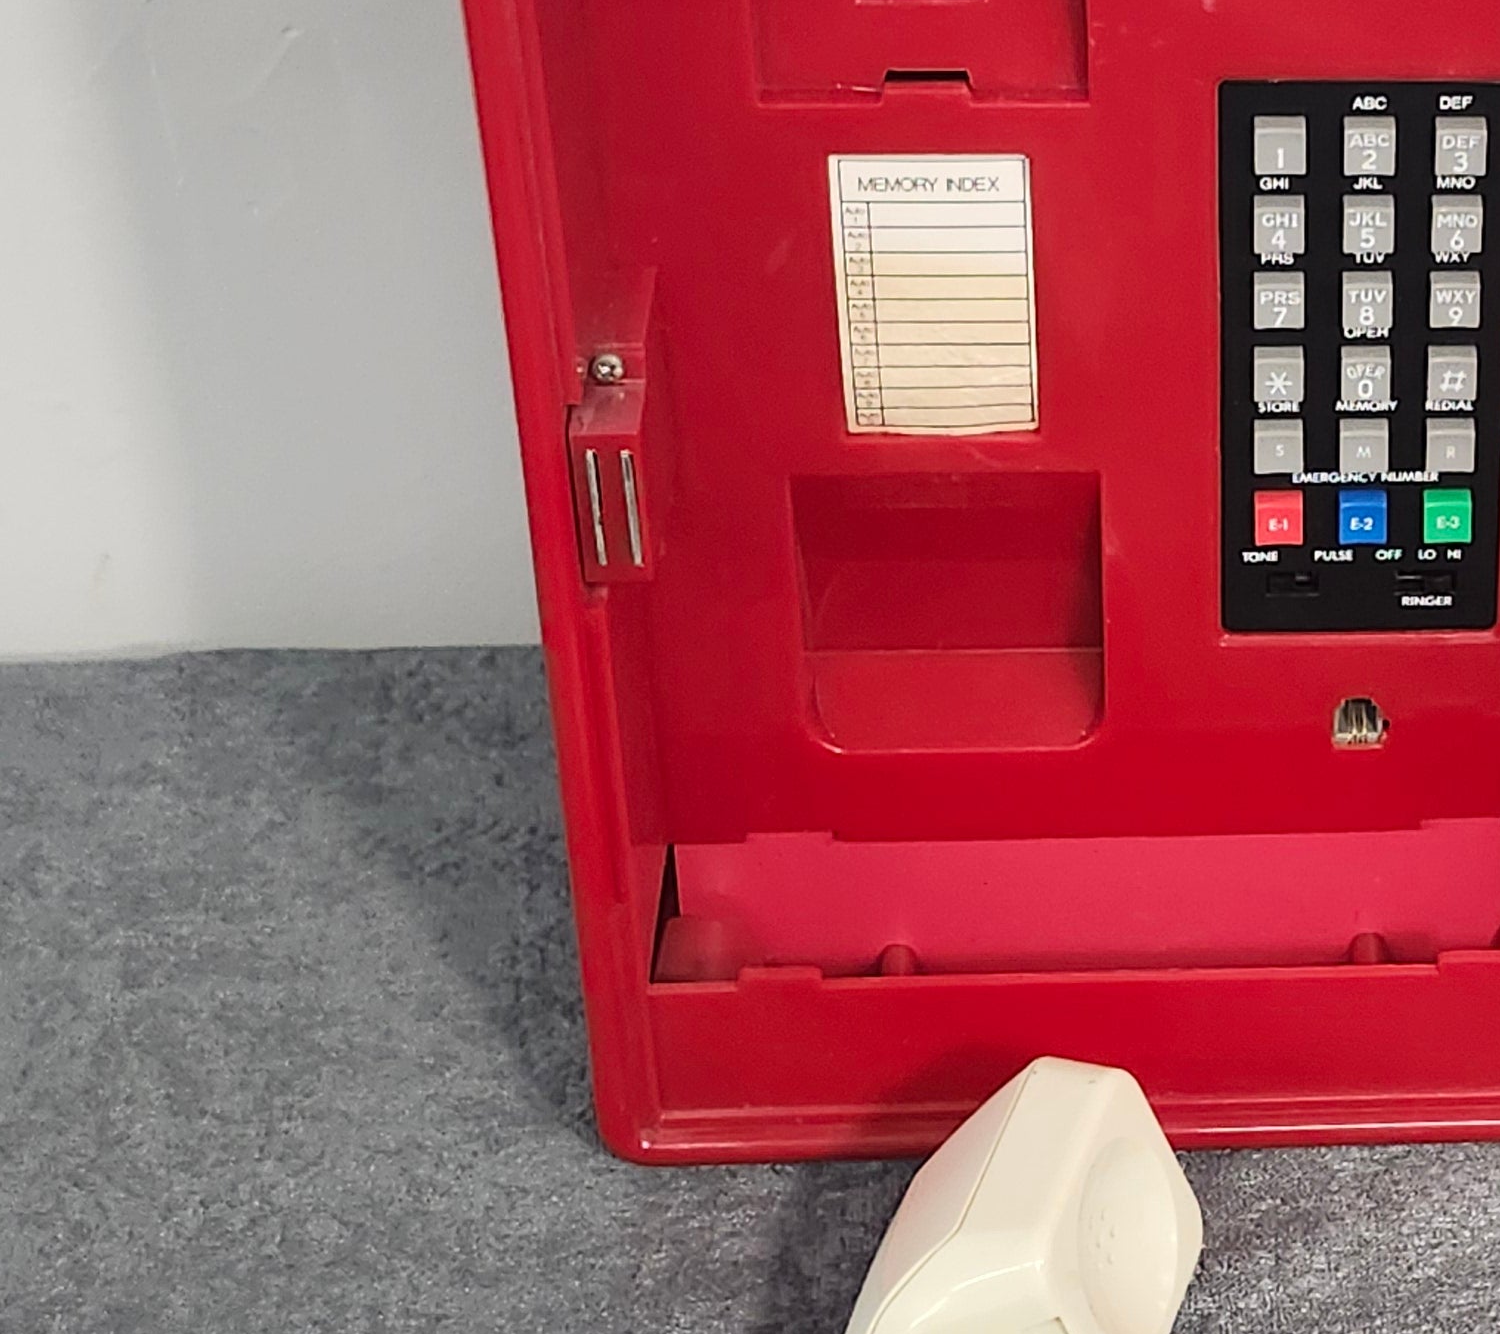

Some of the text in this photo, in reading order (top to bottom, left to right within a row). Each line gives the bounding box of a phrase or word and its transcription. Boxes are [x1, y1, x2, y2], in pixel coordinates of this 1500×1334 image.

[1352, 95, 1388, 110] ABC
[1439, 95, 1474, 110] DEF
[1349, 133, 1390, 148] ABC
[1442, 135, 1481, 149] DEF
[1276, 148, 1285, 169] 1
[1361, 150, 1377, 171] 2
[1453, 152, 1468, 173] 3
[857, 176, 1001, 193] MEMORY INDEX
[1259, 177, 1290, 190] GHI
[1353, 176, 1383, 190] JKL
[1436, 176, 1476, 190] MNO
[1261, 214, 1299, 228] GHI
[1349, 212, 1388, 227] JKL
[1436, 213, 1478, 228] MNO
[1271, 229, 1287, 250] 4
[1360, 228, 1376, 248] 5
[1450, 229, 1465, 250] 6
[1260, 290, 1300, 305] PRS
[1349, 289, 1387, 304] TUV
[1436, 289, 1477, 304] WXY
[1273, 307, 1287, 328] 7
[1359, 305, 1375, 326] 8
[1449, 306, 1464, 327] 9
[1257, 400, 1300, 413] STORE
[1335, 399, 1398, 412] MEMORY
[1425, 400, 1474, 412] REDIAL
[1275, 444, 1285, 457] S
[1356, 445, 1372, 458] M
[1445, 445, 1456, 458] R
[1292, 470, 1440, 484] EMERGENCY NUMBER
[1268, 519, 1289, 532] E-1
[1350, 517, 1374, 531] E-2
[1436, 516, 1461, 529] E-3
[1242, 549, 1354, 563] TONE PULSE
[1375, 549, 1462, 561] OFF LO HI
[1401, 594, 1453, 607] RINGER
